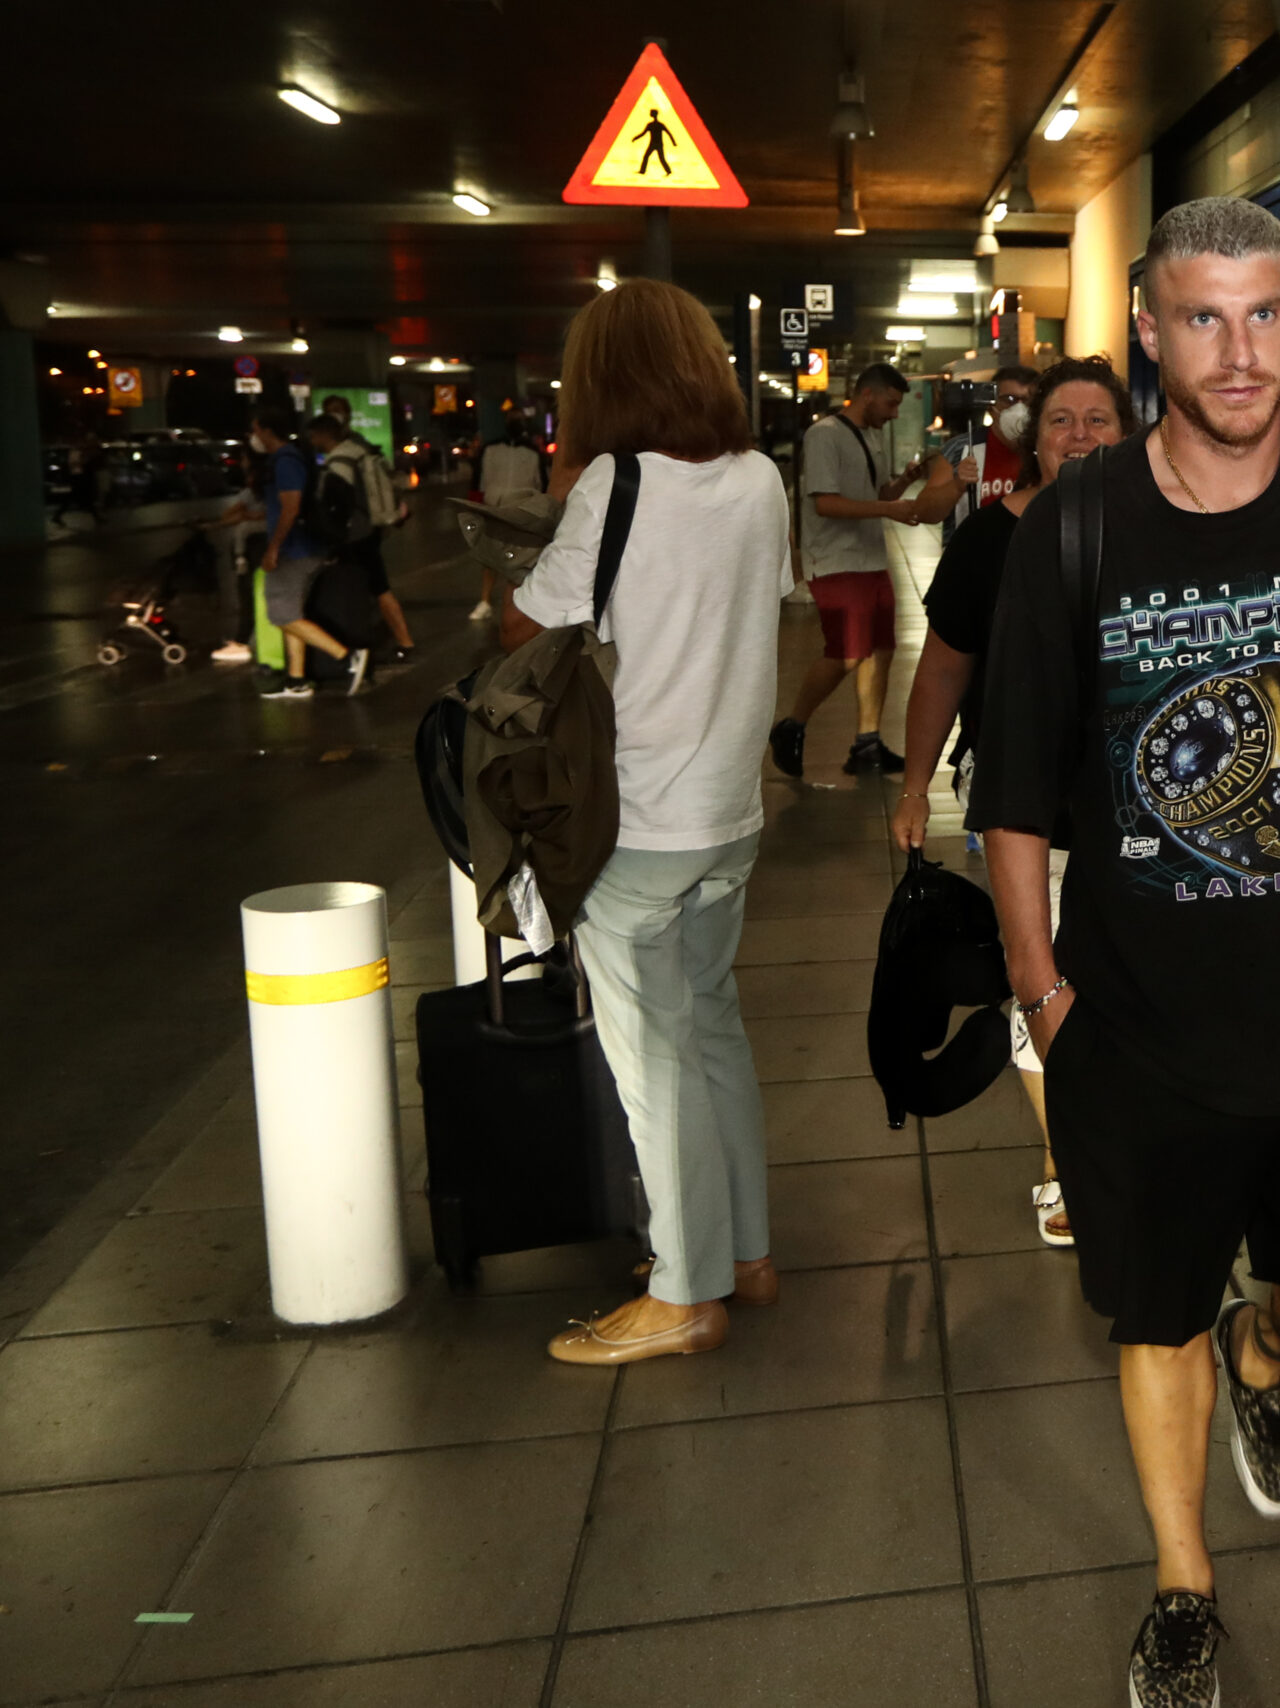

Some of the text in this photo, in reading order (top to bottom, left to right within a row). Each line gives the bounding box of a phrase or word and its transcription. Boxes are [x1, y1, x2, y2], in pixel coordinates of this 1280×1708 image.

[1120, 583, 1230, 610] 2001
[1139, 650, 1214, 672] BACK
[1226, 643, 1259, 660] TO
[1159, 728, 1266, 821] CHAMPIONS
[1207, 797, 1273, 840] 2001
[1130, 840, 1155, 849] NBA
